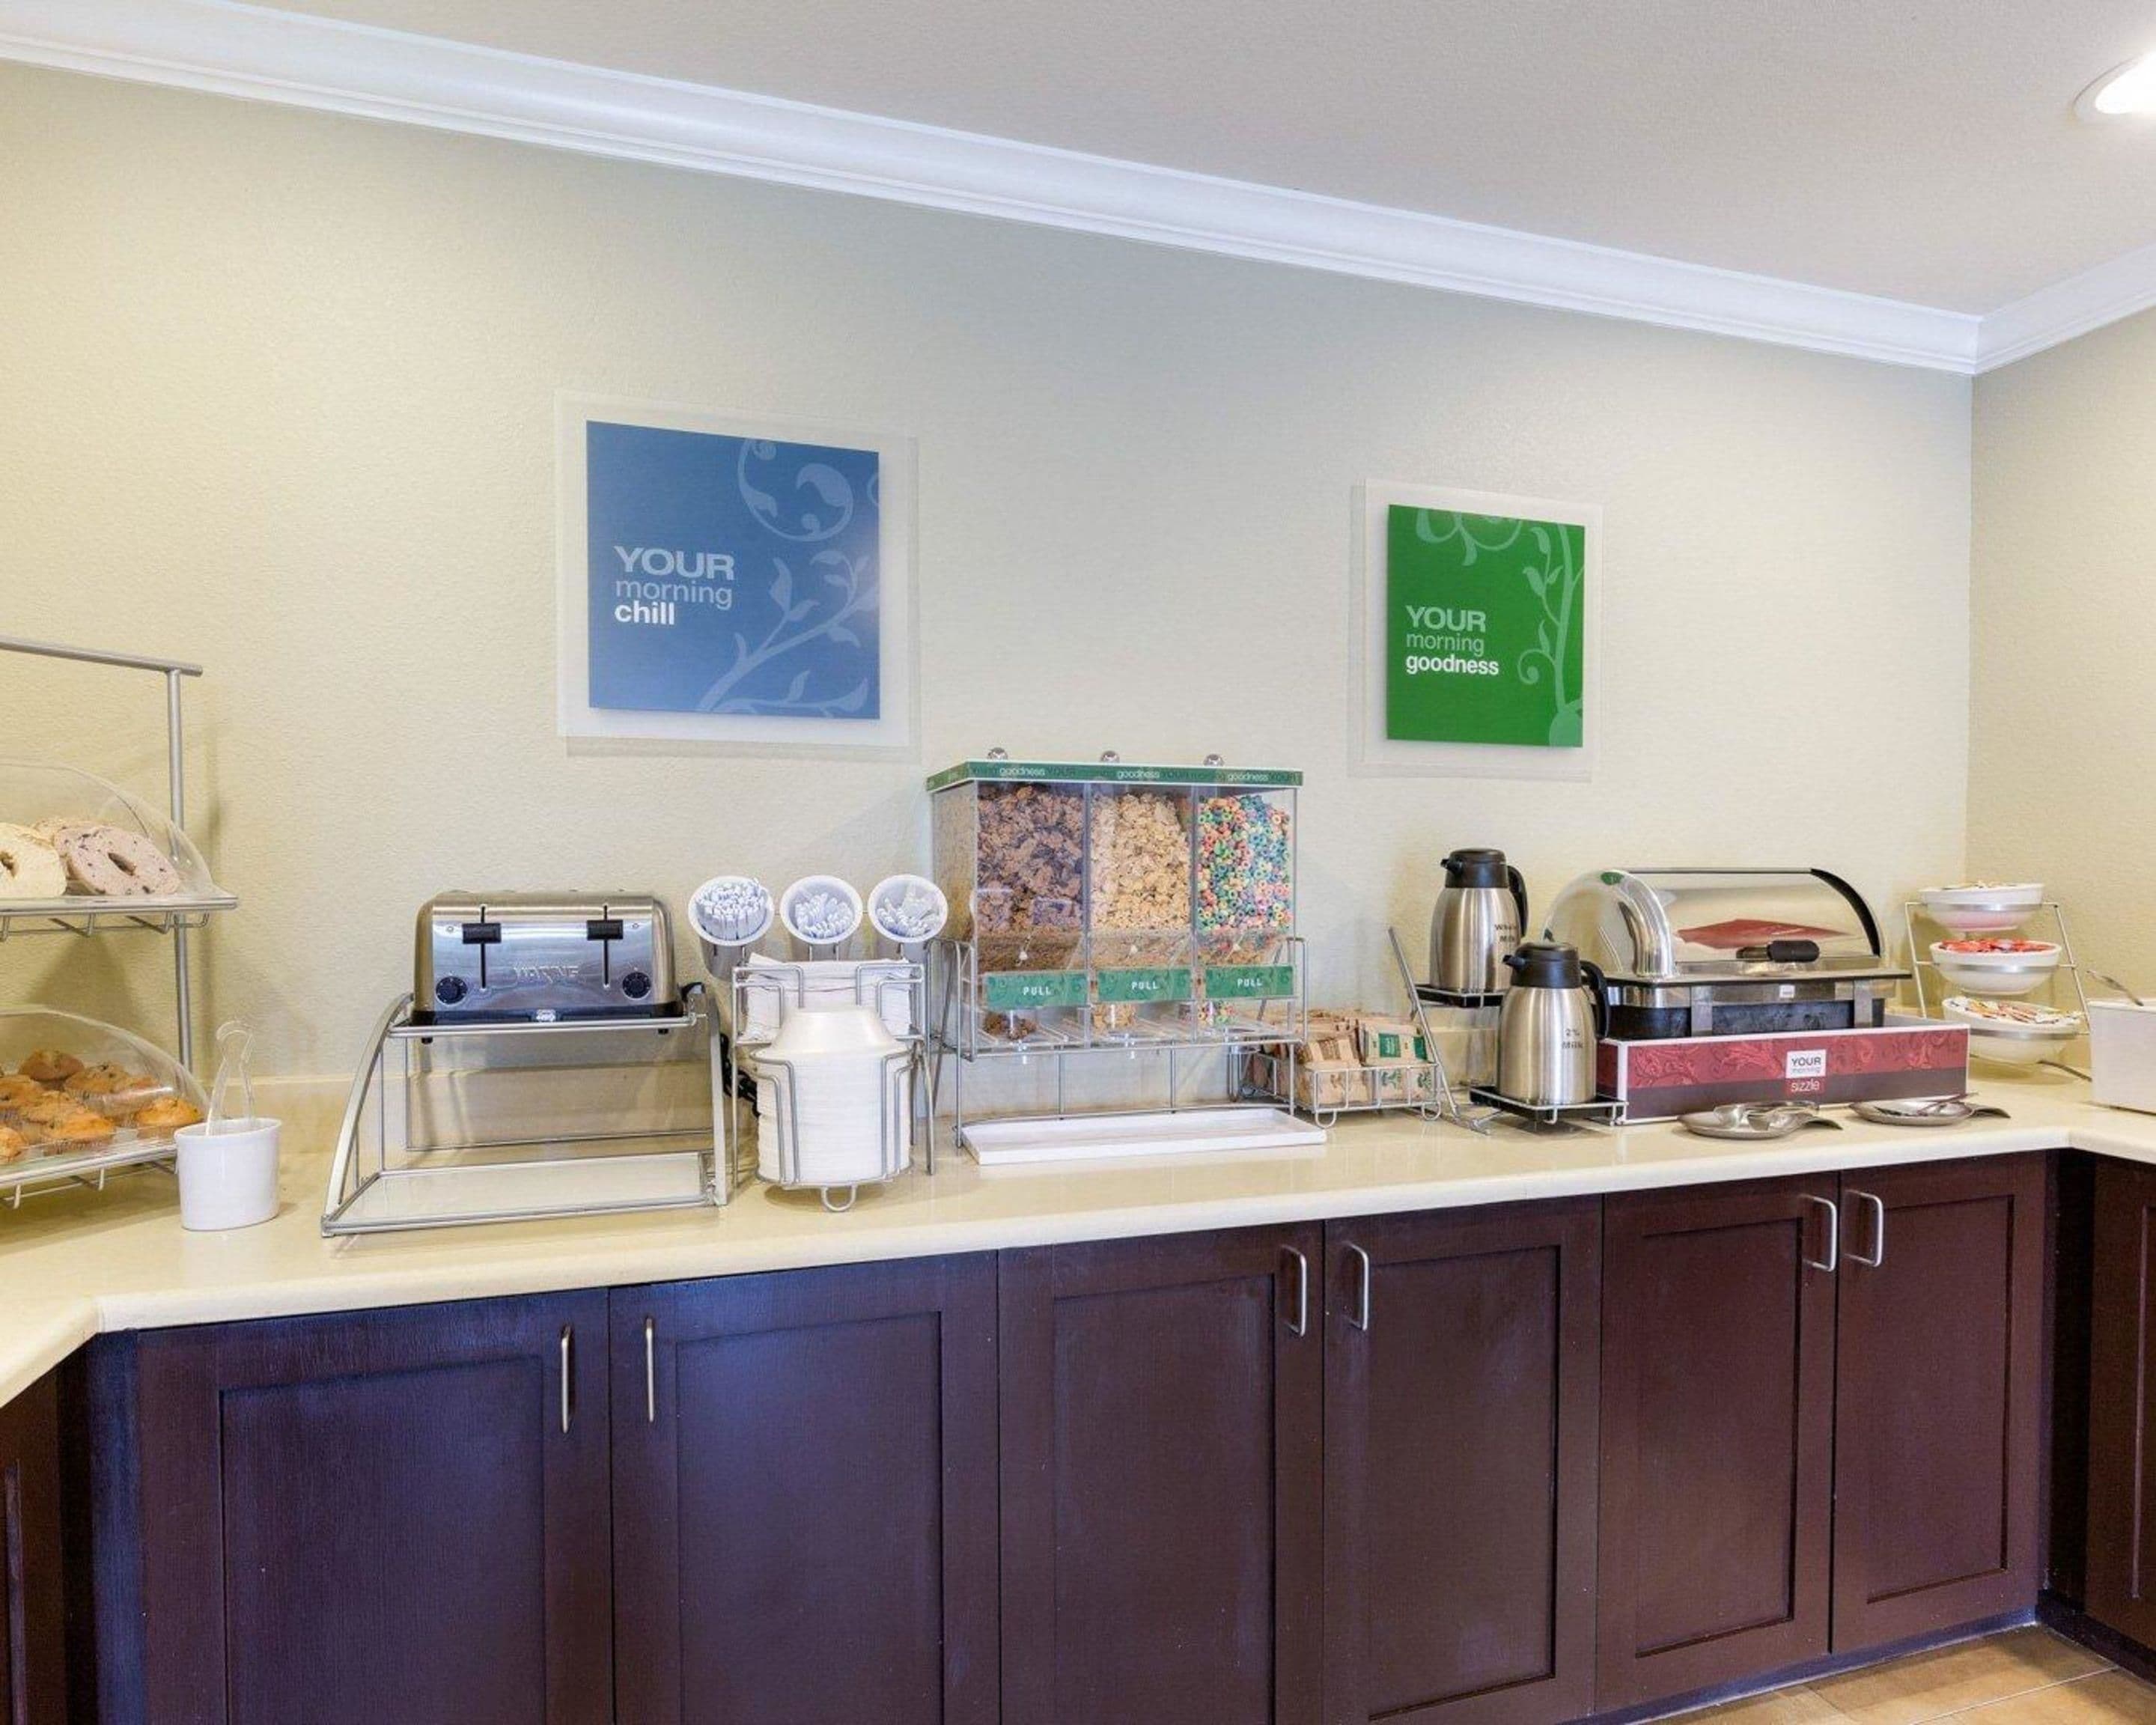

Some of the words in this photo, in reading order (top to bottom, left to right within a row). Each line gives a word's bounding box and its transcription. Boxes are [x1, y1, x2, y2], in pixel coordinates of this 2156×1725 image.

[614, 546, 735, 580] YOUR
[615, 580, 733, 610] morning
[615, 600, 674, 625] chill
[1405, 605, 1486, 633] YOUR
[1407, 633, 1484, 657] morning
[1407, 653, 1499, 675] goodness
[999, 767, 1046, 777] goodness
[1116, 769, 1160, 780] goodness
[1228, 772, 1270, 782] goodness
[1131, 981, 1160, 991] PULL
[1237, 978, 1264, 988] PULL
[1023, 986, 1052, 996] PULL
[1565, 1028, 1580, 1037] 2%
[1562, 1041, 1583, 1049] Milk
[1791, 1056, 1822, 1067] YOUR
[1791, 1078, 1820, 1092] sizzle
